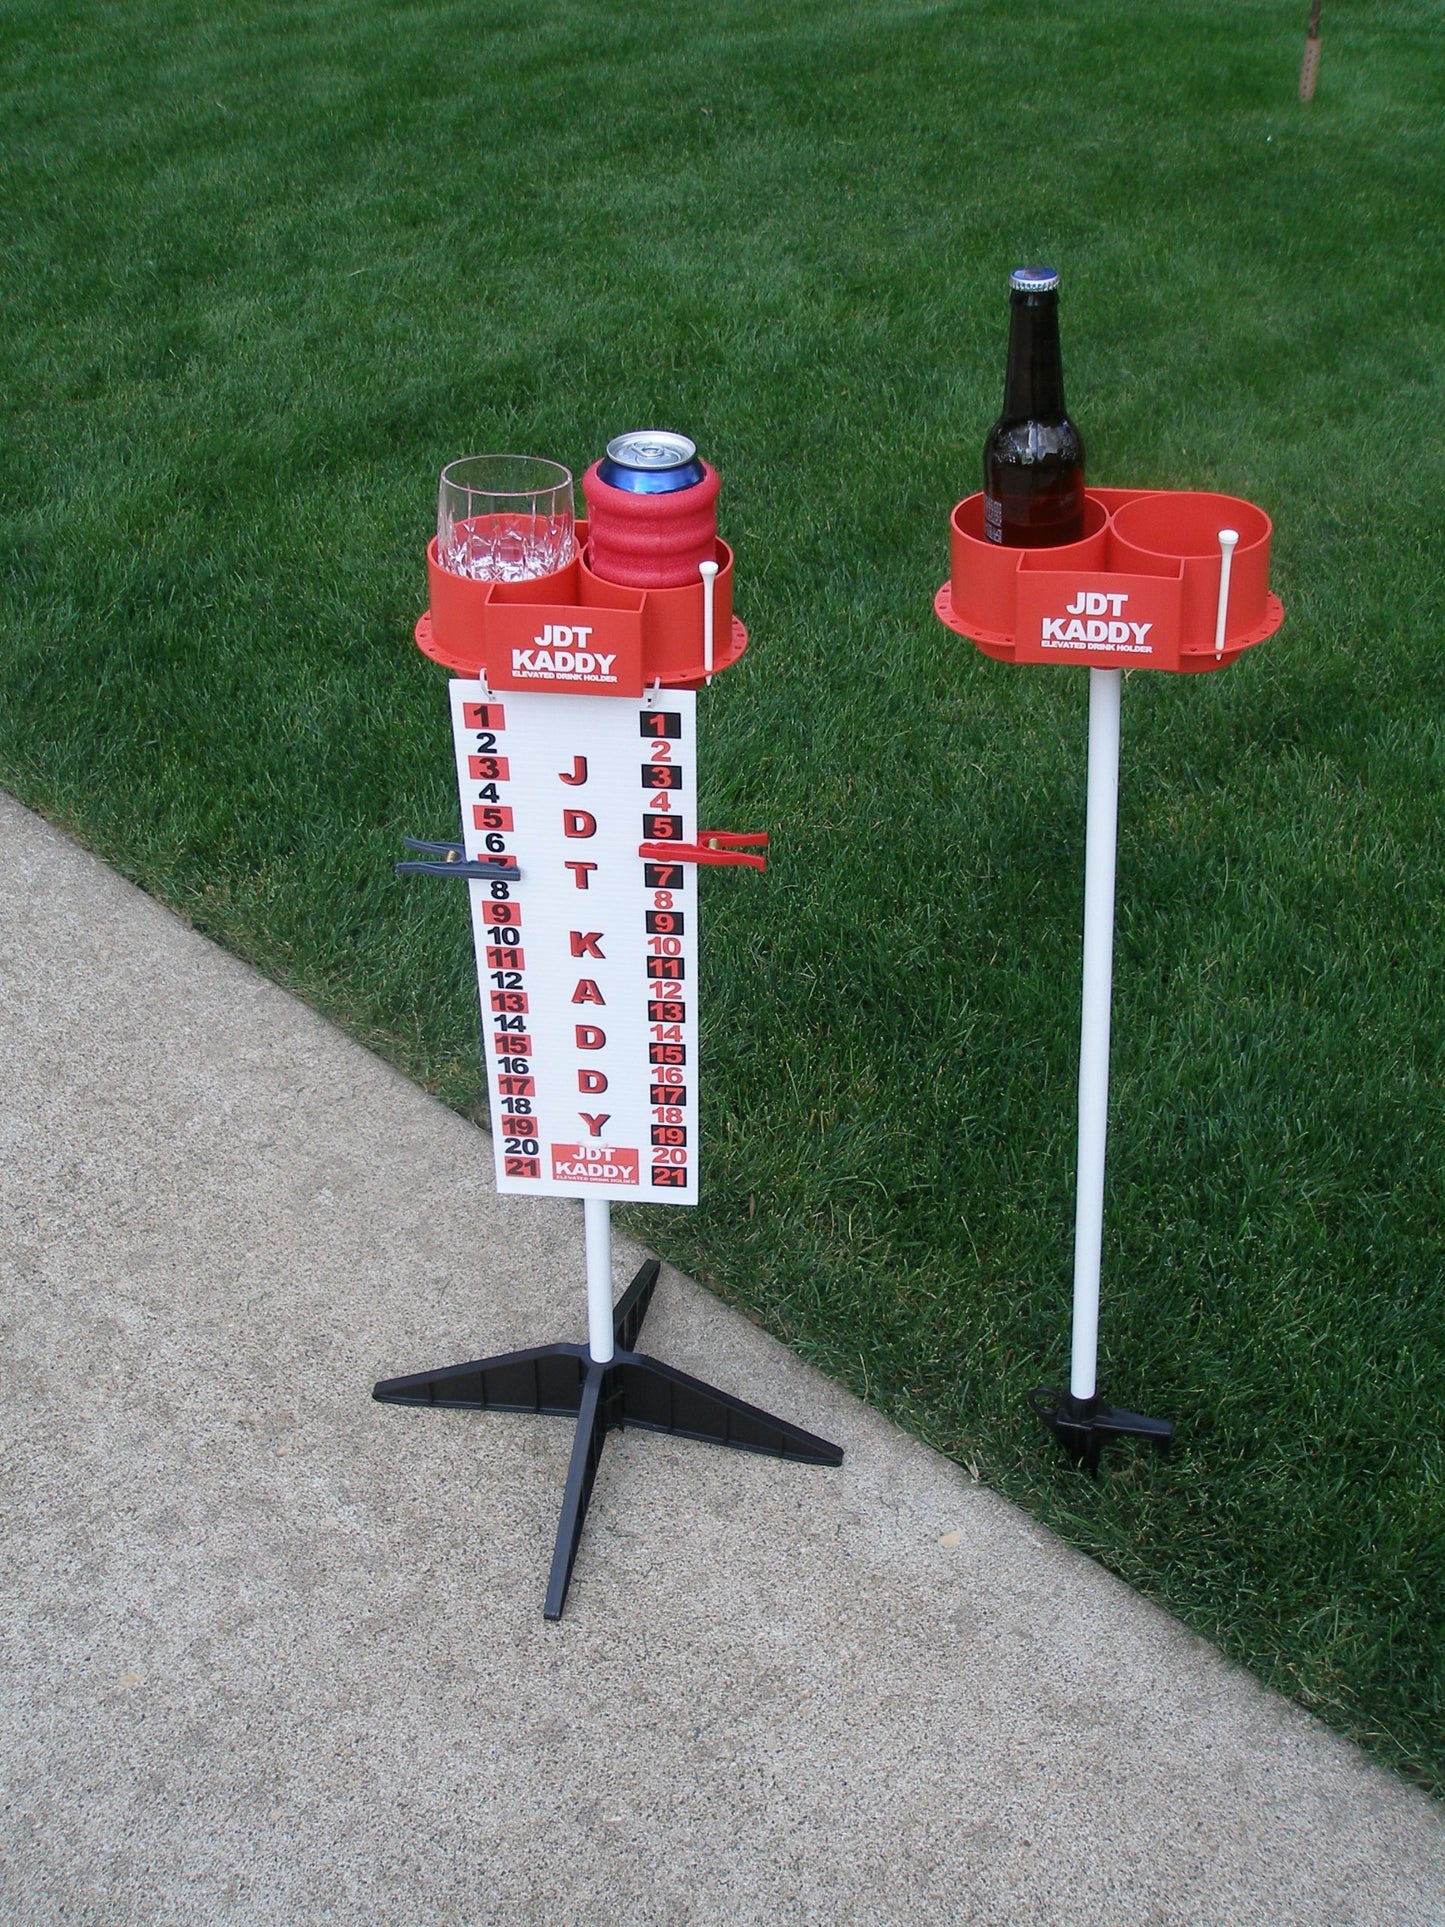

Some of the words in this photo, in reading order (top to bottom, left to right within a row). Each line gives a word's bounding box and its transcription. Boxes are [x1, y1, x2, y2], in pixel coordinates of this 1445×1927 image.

[1067, 593, 1128, 616] JDT
[535, 625, 592, 648] JDT
[1041, 618, 1152, 644] KADDY
[1041, 641, 1086, 649] ELEVATED
[1087, 643, 1116, 652] DRINK
[1116, 645, 1152, 653] HOLDER
[512, 649, 616, 674] KADDY
[512, 671, 556, 679] ELEVATED
[556, 673, 583, 681] DRINK
[473, 705, 489, 727] 1
[649, 714, 665, 736] 1
[476, 733, 497, 754] 2
[651, 741, 671, 762] 2
[479, 758, 500, 779] 3
[651, 767, 672, 788] 3
[479, 783, 499, 803] 4
[649, 791, 670, 812] 4
[483, 808, 503, 829] 5
[651, 817, 672, 838] 5
[485, 833, 505, 853] 6
[654, 866, 675, 887] 7
[490, 881, 510, 900] 8
[654, 890, 673, 910] 8
[492, 904, 512, 923] 9
[655, 914, 674, 933] 9
[487, 927, 519, 946] 10
[647, 937, 681, 956] 10
[489, 949, 518, 967] 11
[651, 959, 680, 977] 11
[491, 971, 523, 989] 12
[649, 982, 682, 1000] 12
[492, 994, 524, 1012] 13
[651, 1003, 682, 1021] 13
[494, 1014, 526, 1032] 14
[650, 1024, 683, 1042] 14
[497, 1036, 527, 1054] 15
[652, 1046, 682, 1063] 15
[498, 1056, 529, 1074] 16
[652, 1066, 683, 1084] 16
[499, 1077, 530, 1095] 17
[652, 1087, 683, 1104] 17
[501, 1097, 531, 1114] 18
[652, 1107, 682, 1124] 18
[504, 1118, 533, 1135] 19
[654, 1128, 683, 1145] 19
[505, 1138, 539, 1155] 20
[571, 1146, 616, 1162] JDT
[652, 1148, 687, 1165] 20
[506, 1159, 537, 1176] 21
[555, 1161, 634, 1178] KADDY
[654, 1169, 684, 1185] 21
